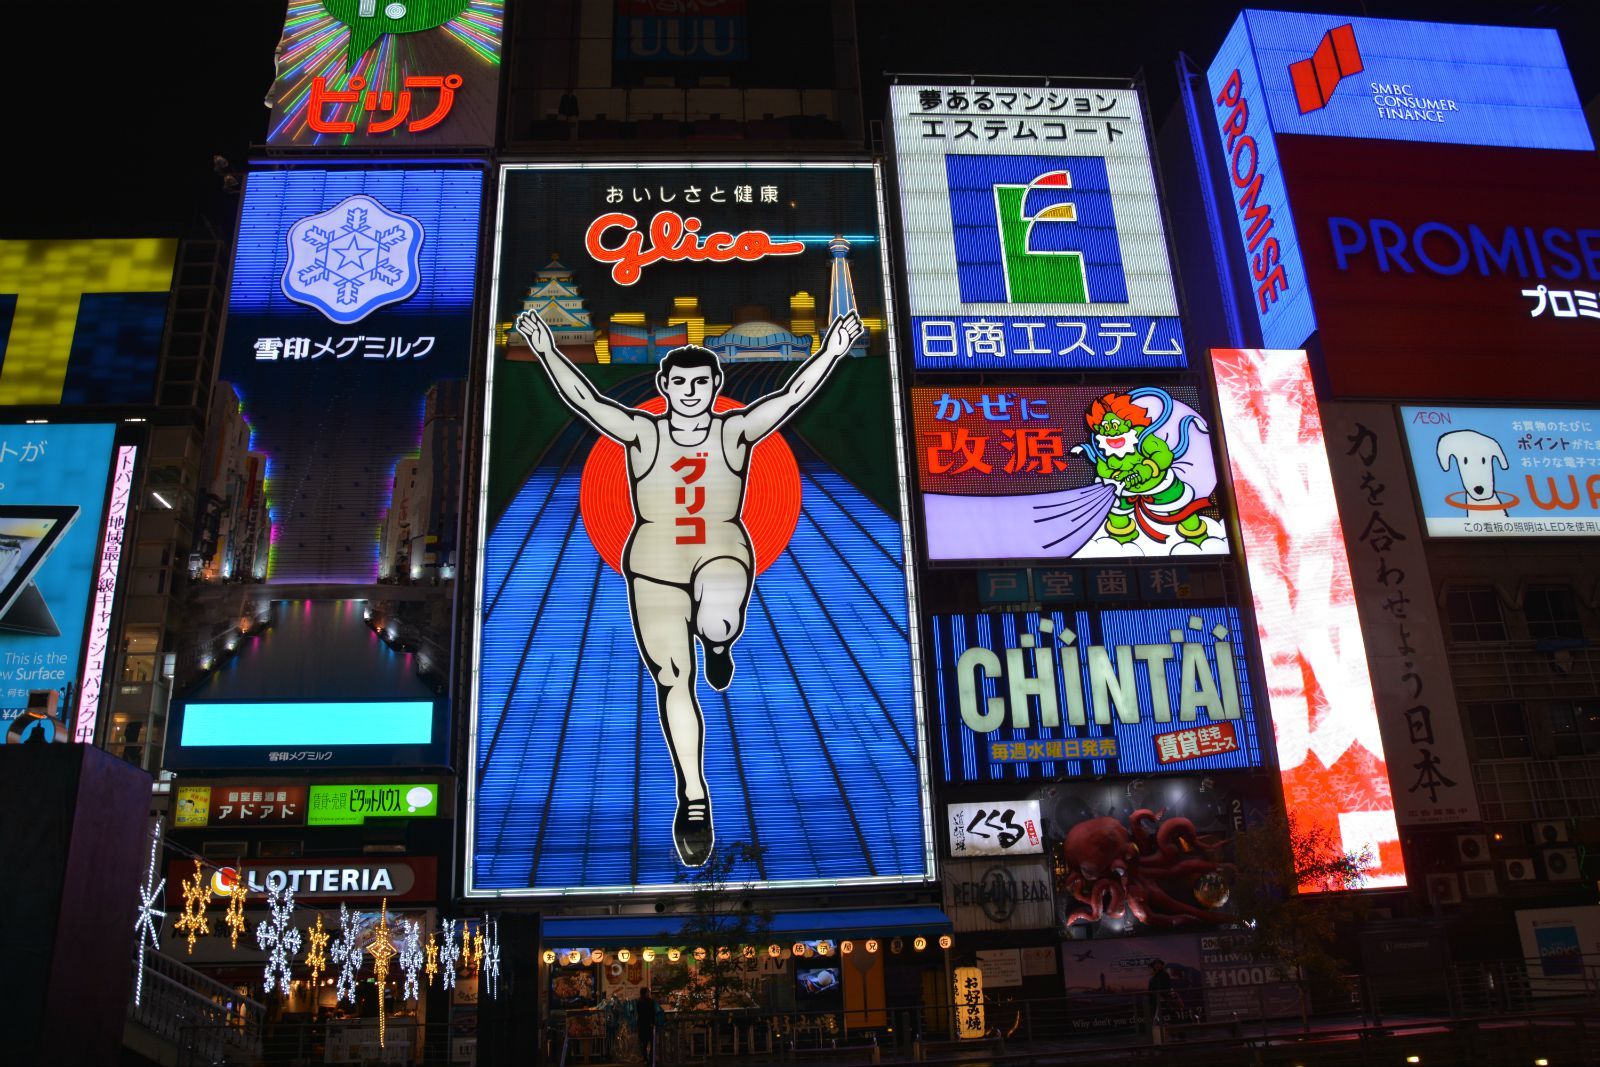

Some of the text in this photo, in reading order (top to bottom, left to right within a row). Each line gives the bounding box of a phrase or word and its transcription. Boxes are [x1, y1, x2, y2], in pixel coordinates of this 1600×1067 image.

[918, 89, 1118, 112] 夢あるマンション
[1371, 82, 1413, 97] SMBC
[306, 74, 463, 134] ピップ
[1374, 95, 1459, 112] CONSUMER
[1378, 107, 1445, 124] FINANCE
[922, 121, 1124, 143] エステムコート
[605, 185, 780, 205] おいしさと健康
[1216, 69, 1288, 314] PROMISE
[585, 210, 806, 286] Glico
[1328, 216, 1600, 281] PROMISE
[1521, 285, 1600, 318] プロミ
[253, 335, 436, 362] 雪印メグミルク
[921, 319, 1183, 358] 日商エステム
[933, 392, 1050, 423] かぜに
[1511, 420, 1593, 432] お買物のたびに
[924, 427, 1070, 475] 改源
[1520, 457, 1600, 469] おトクな電子マ
[670, 452, 709, 545] グリコ
[1345, 422, 1457, 804] 力を合わせよう日本
[5, 652, 68, 665] This is the
[16, 666, 66, 681] Surface
[268, 751, 333, 762] 雪印メグミルク
[991, 738, 1118, 760] 毎週水曜日発売
[1157, 726, 1236, 762] 賃貸 住宅 ニュース
[218, 803, 296, 820] アドアド
[349, 788, 401, 813] ピタットハウス
[966, 808, 1025, 849] くくる
[248, 868, 393, 893] LOTTERIA
[1021, 878, 1050, 901] BAR
[963, 976, 982, 1031] お好み焼
